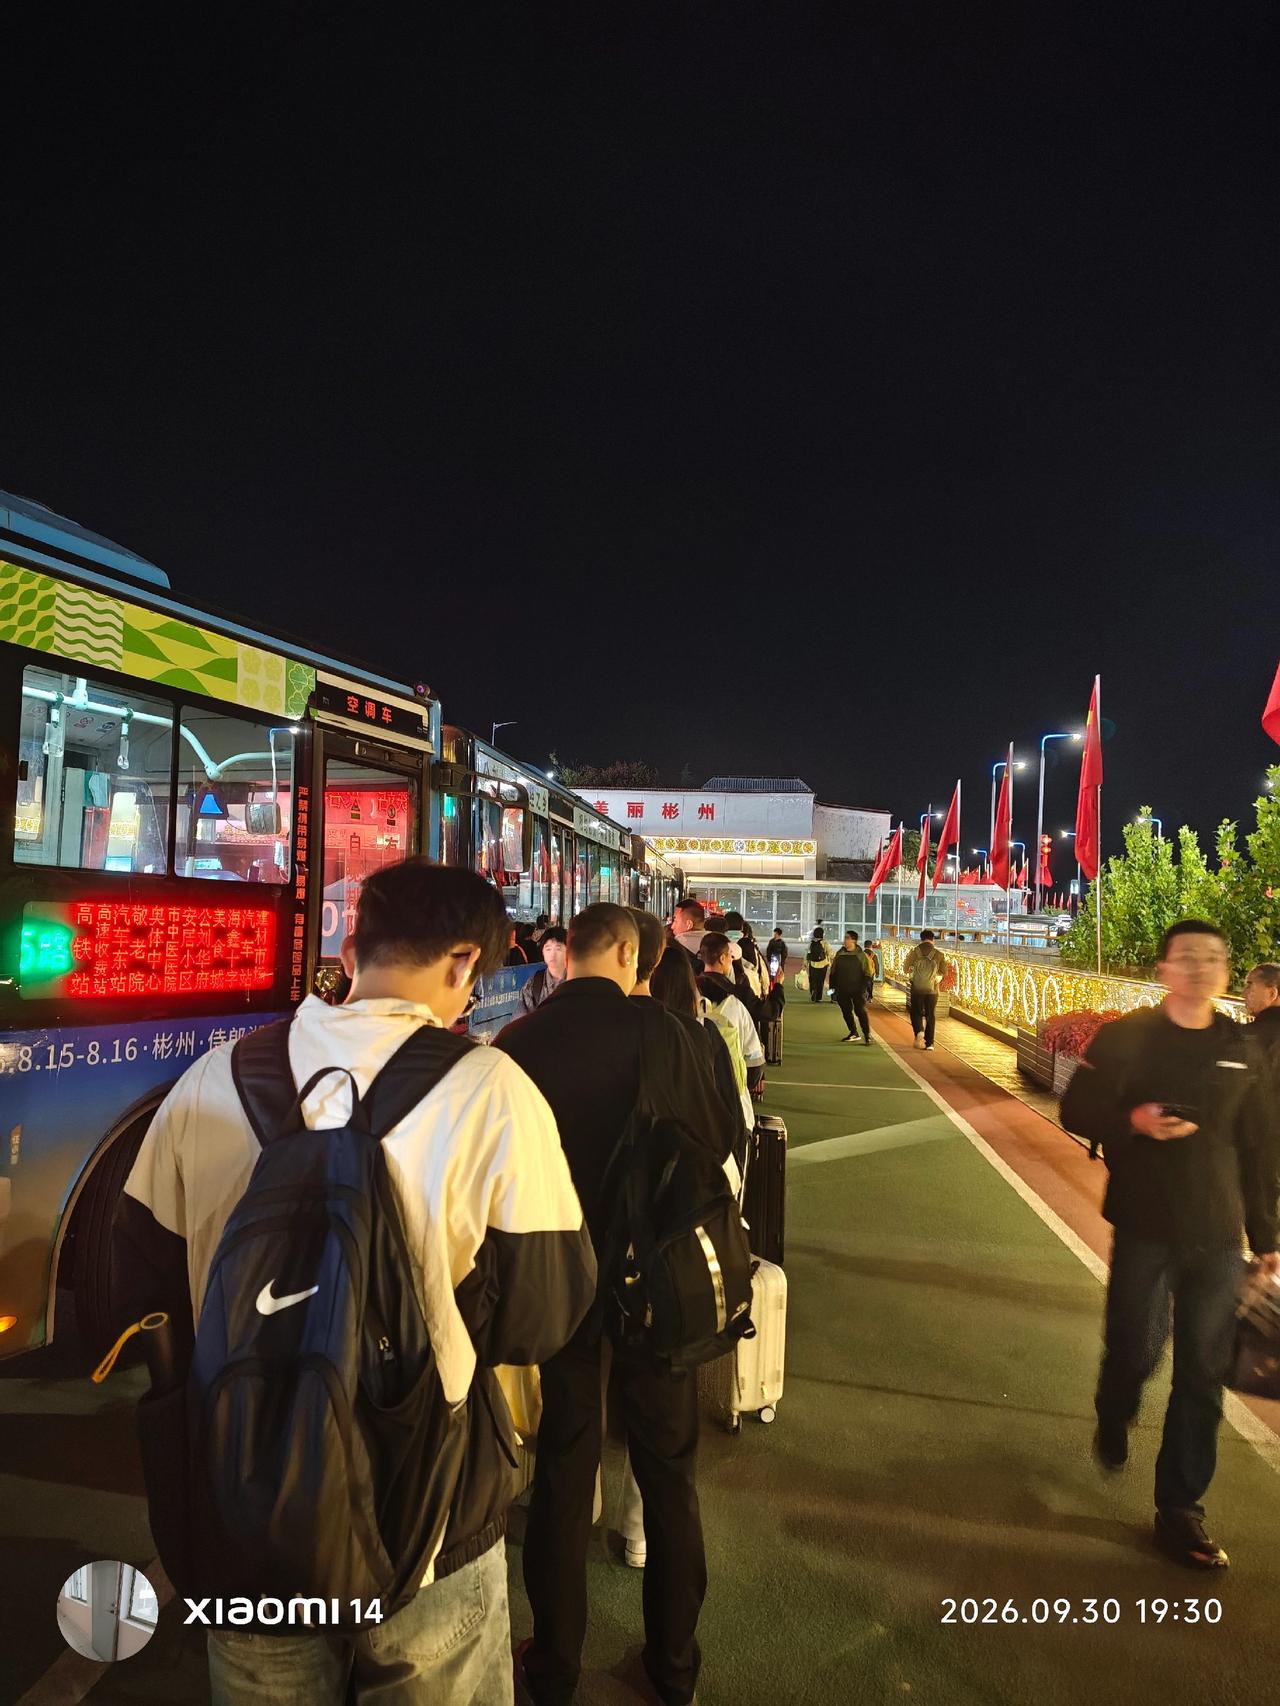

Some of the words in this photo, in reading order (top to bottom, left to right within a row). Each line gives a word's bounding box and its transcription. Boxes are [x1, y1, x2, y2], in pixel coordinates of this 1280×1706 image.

[346, 695, 393, 725] 空调车
[593, 799, 715, 820] 美丽彬州
[70, 903, 94, 994] 高铁站
[93, 904, 112, 995] 高速收费站
[110, 904, 130, 993] 汽车东站
[129, 904, 148, 993] 敬老院
[145, 905, 165, 991] 奥体中心
[164, 906, 181, 993] 市中医医院
[180, 906, 197, 991] 安居小区
[195, 908, 212, 990] 公刘华府
[210, 908, 226, 989] 美食城
[240, 909, 255, 988] 汽车站
